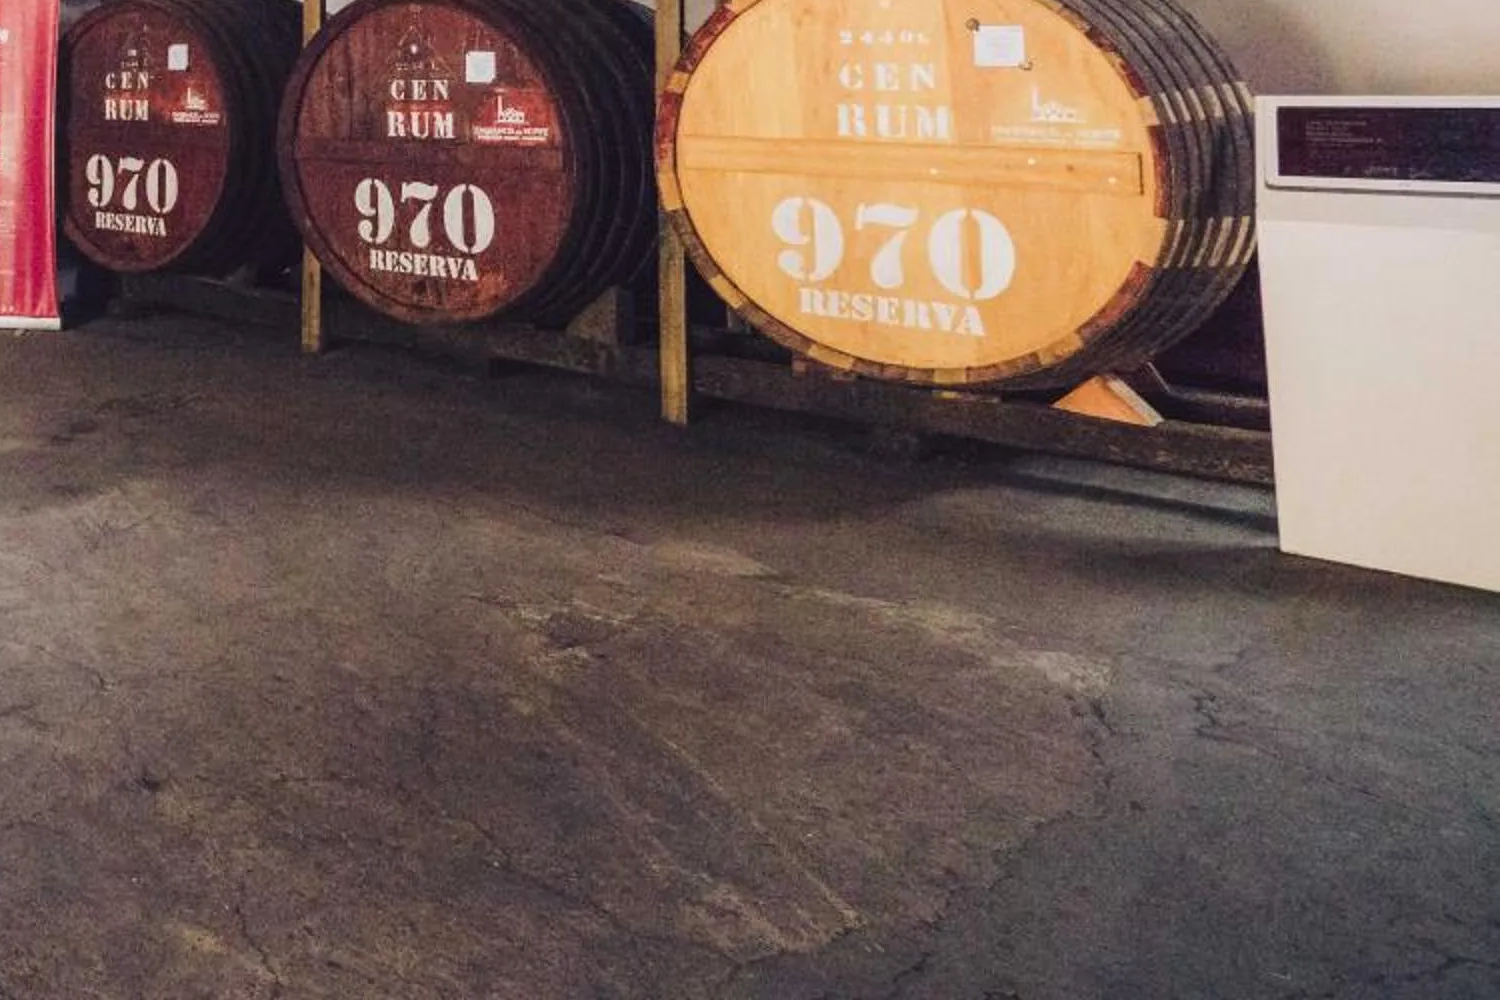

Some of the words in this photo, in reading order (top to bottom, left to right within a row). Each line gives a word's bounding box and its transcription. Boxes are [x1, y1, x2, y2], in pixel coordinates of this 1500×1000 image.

[104, 71, 150, 90] CEN
[390, 79, 450, 101] CEN
[838, 62, 935, 91] CEN
[104, 98, 150, 121] RUM
[386, 110, 456, 139] RUM
[835, 102, 952, 141] RUM
[85, 153, 179, 214] 970
[95, 210, 168, 237] RESERVA
[354, 177, 496, 255] 970
[770, 196, 1017, 301] 970
[368, 249, 479, 282] RESERVA
[798, 287, 986, 337] RESERVA
